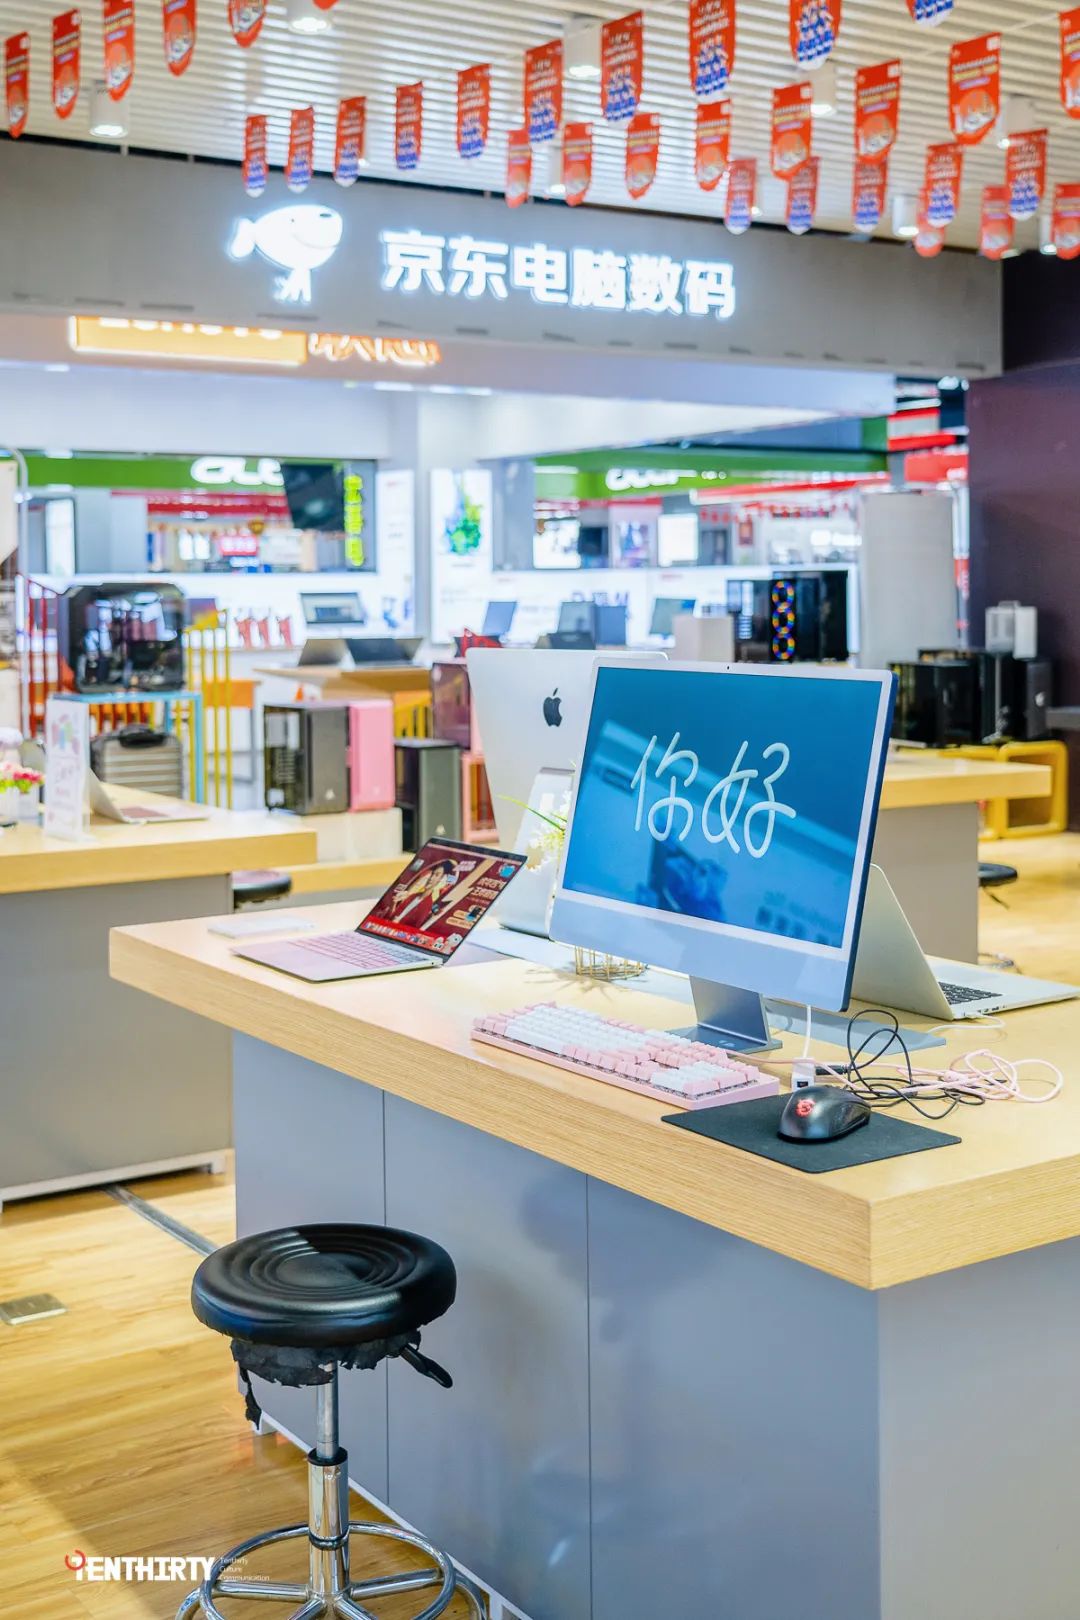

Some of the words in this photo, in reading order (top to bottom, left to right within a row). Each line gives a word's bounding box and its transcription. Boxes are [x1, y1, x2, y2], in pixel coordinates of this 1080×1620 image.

[380, 230, 735, 319] 京东电脑数码
[631, 732, 797, 858] 你好
